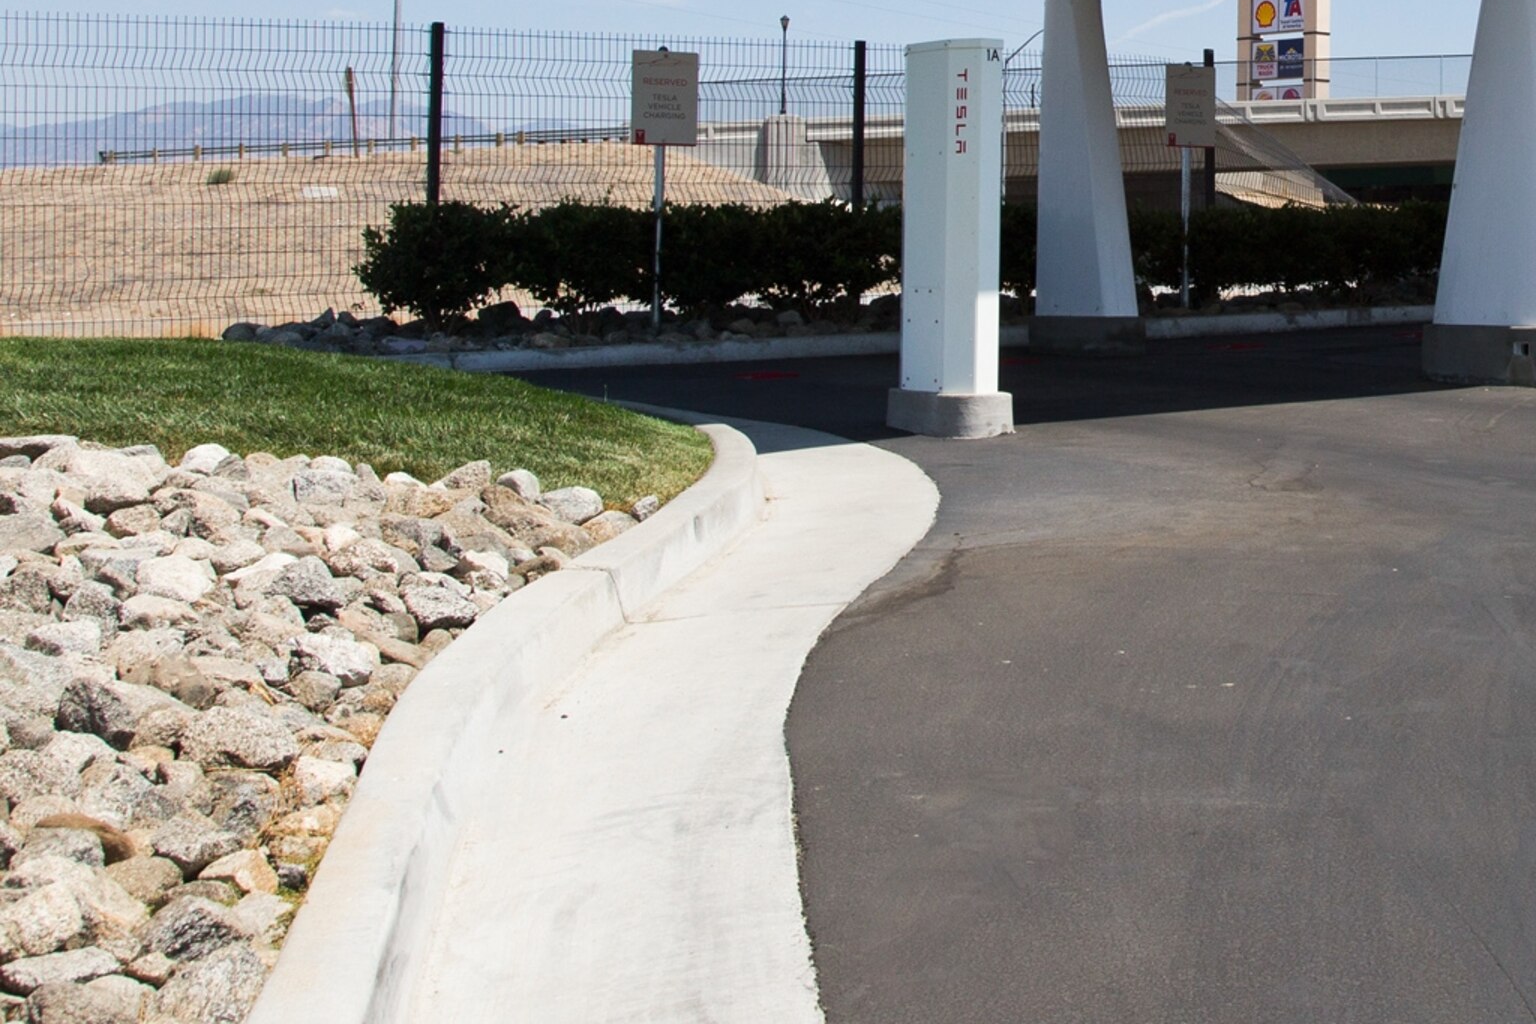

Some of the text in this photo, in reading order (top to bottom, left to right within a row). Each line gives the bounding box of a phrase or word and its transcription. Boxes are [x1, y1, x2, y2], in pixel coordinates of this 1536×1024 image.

[986, 48, 1000, 61] 1A
[643, 77, 688, 87] RESERVED
[653, 94, 678, 102] TESLA
[648, 102, 682, 111] VEHICLE
[955, 68, 968, 154] TESLA
[643, 111, 686, 120] CHARGING
